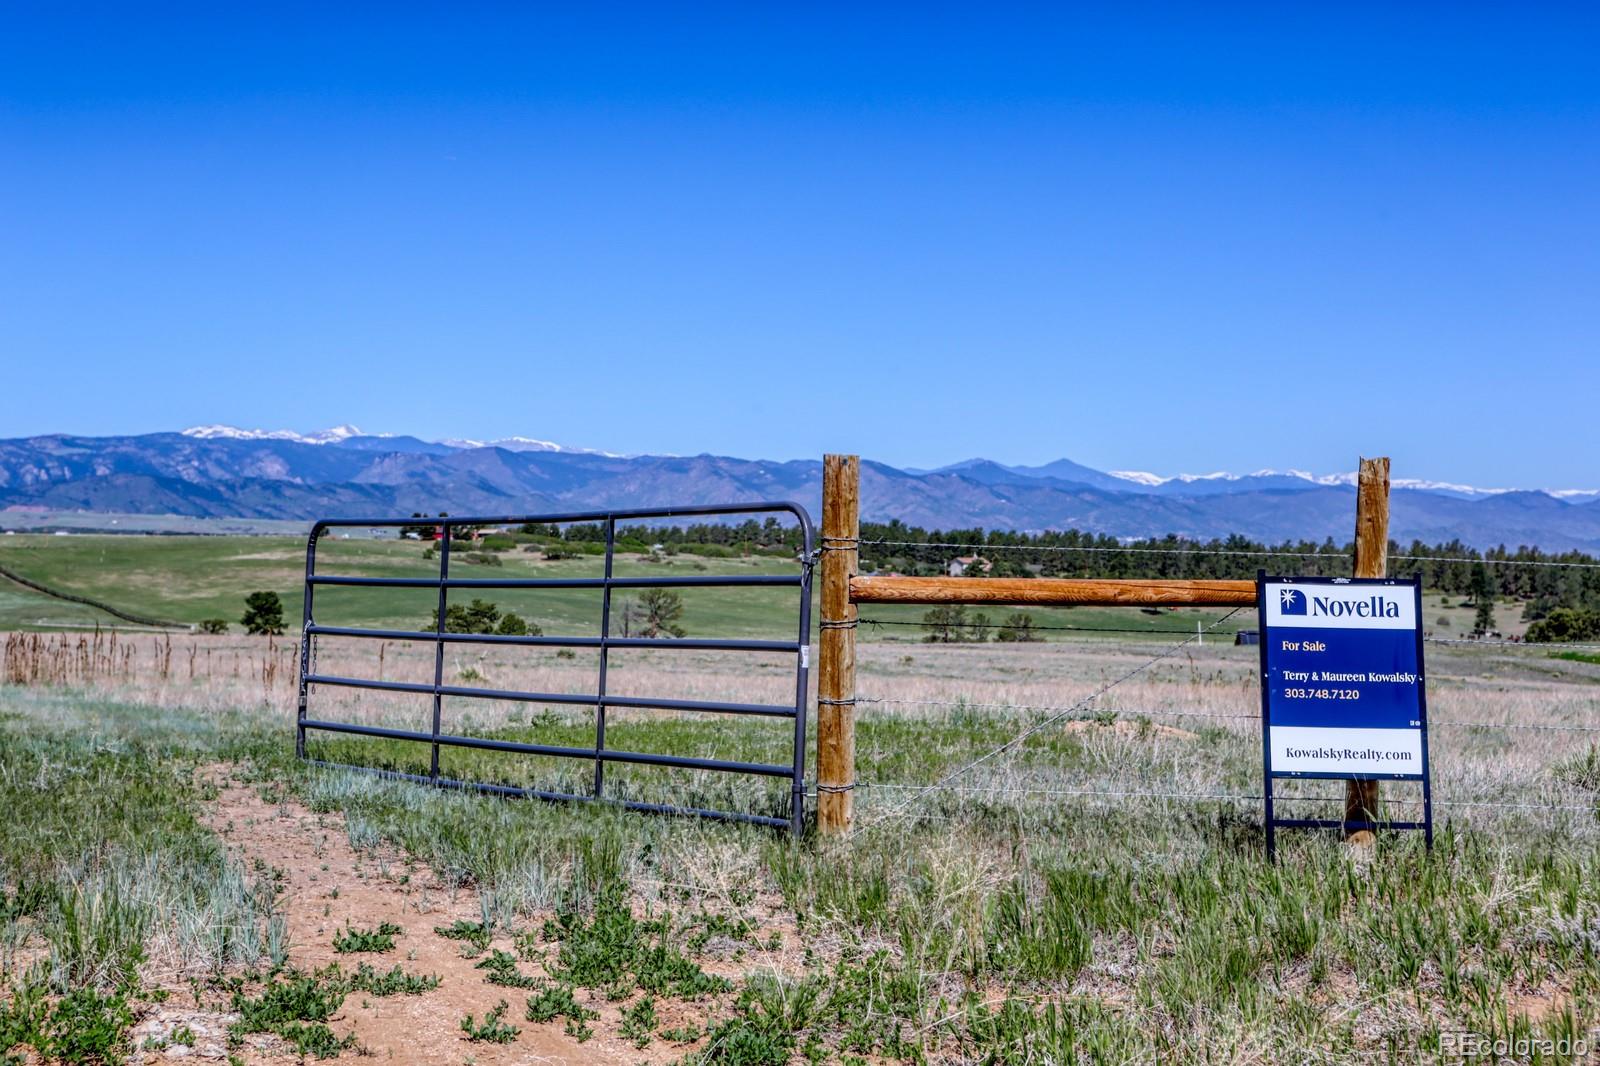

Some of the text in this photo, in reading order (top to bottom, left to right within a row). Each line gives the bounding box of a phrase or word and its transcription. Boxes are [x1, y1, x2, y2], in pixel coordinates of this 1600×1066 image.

[1312, 596, 1400, 618] Novella
[1282, 641, 1326, 652] For Sale
[1283, 671, 1417, 685] Terry & Maureen Kowalsky
[1284, 688, 1360, 700] 303.748.7120
[1286, 747, 1412, 762] KowalskyRealty.com
